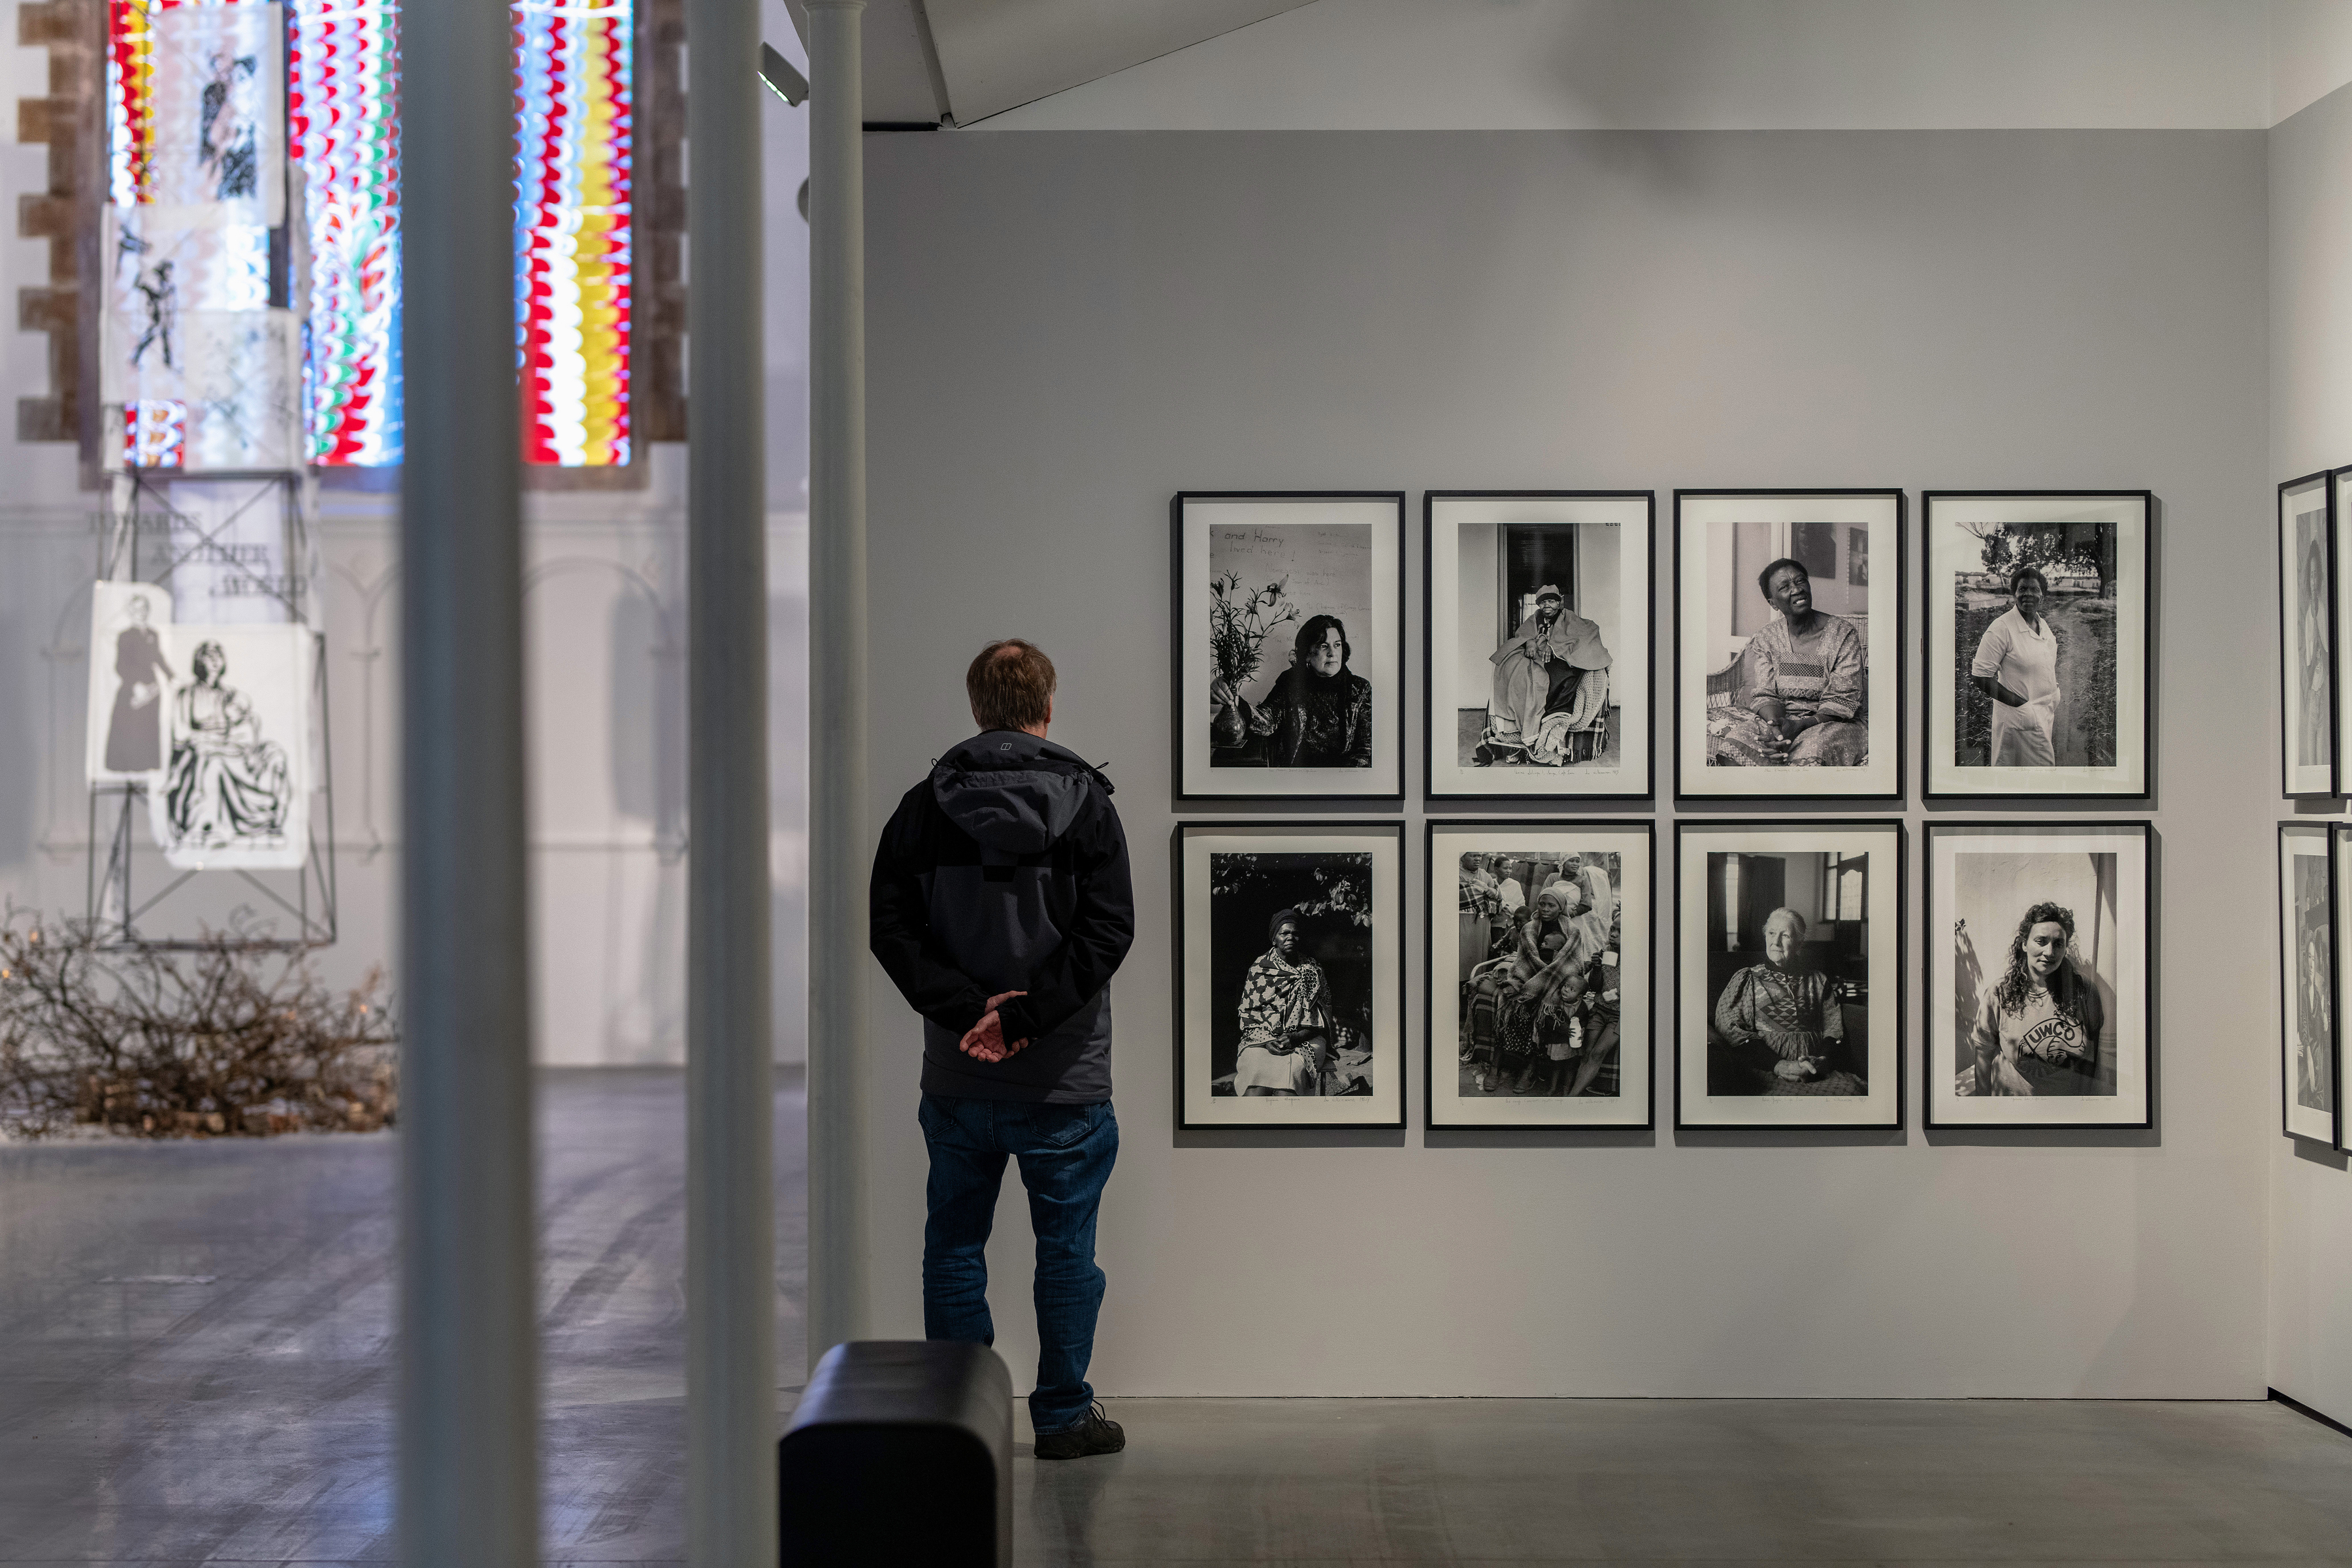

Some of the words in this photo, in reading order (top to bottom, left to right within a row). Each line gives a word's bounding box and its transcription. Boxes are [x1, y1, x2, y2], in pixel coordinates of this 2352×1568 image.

[1224, 532, 1246, 540] and
[1254, 528, 1284, 547] Harry
[1230, 540, 1254, 553] lived
[2028, 1021, 2075, 1043] UWCO
